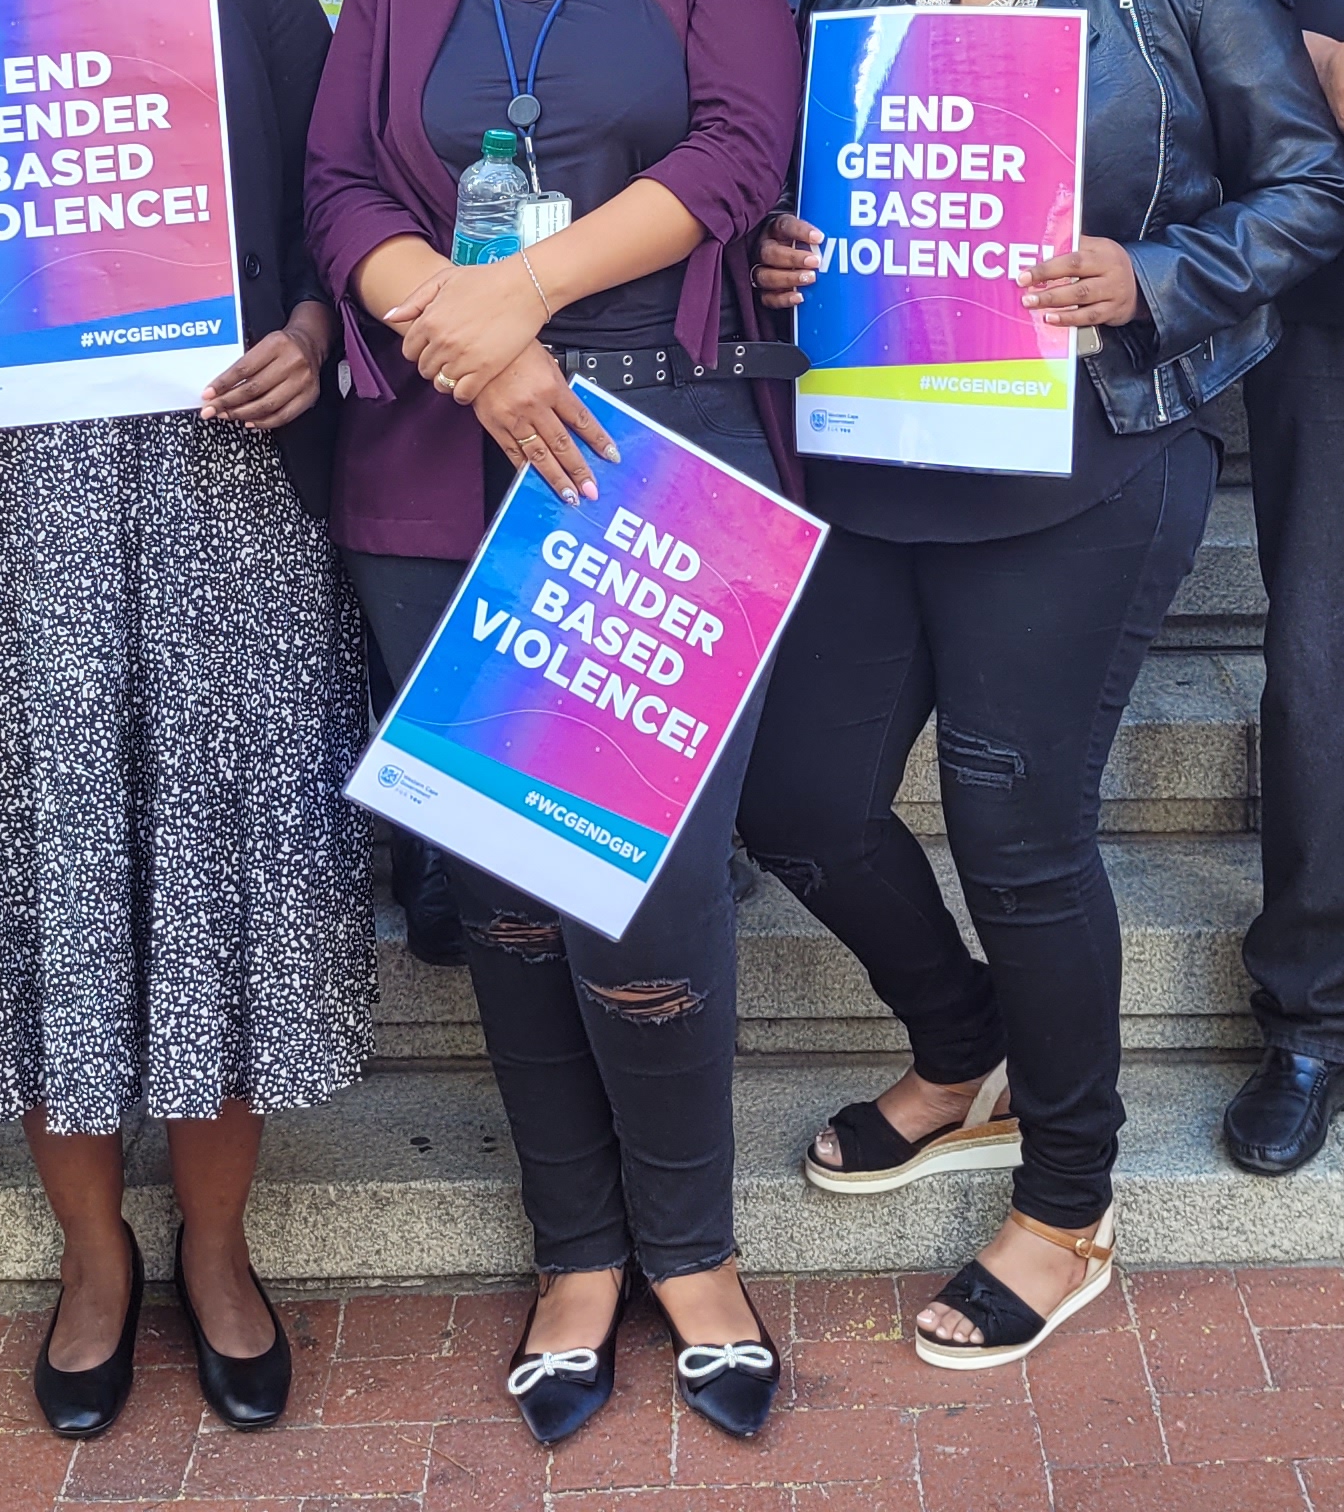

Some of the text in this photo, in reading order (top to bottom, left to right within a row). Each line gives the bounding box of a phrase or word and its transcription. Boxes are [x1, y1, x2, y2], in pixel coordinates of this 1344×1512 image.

[4, 50, 112, 94] END
[879, 95, 975, 133] END
[836, 143, 1026, 183] GENDER
[849, 192, 1004, 230] BASED
[80, 319, 222, 347] #WCGENDGBV
[919, 376, 1052, 398] #WCGENDGBV
[601, 506, 703, 583] END
[541, 528, 725, 656] GENDER
[531, 580, 686, 687] BASED
[471, 597, 710, 759] VIOLENCE!
[524, 788, 648, 864] #WCGENDGBV
